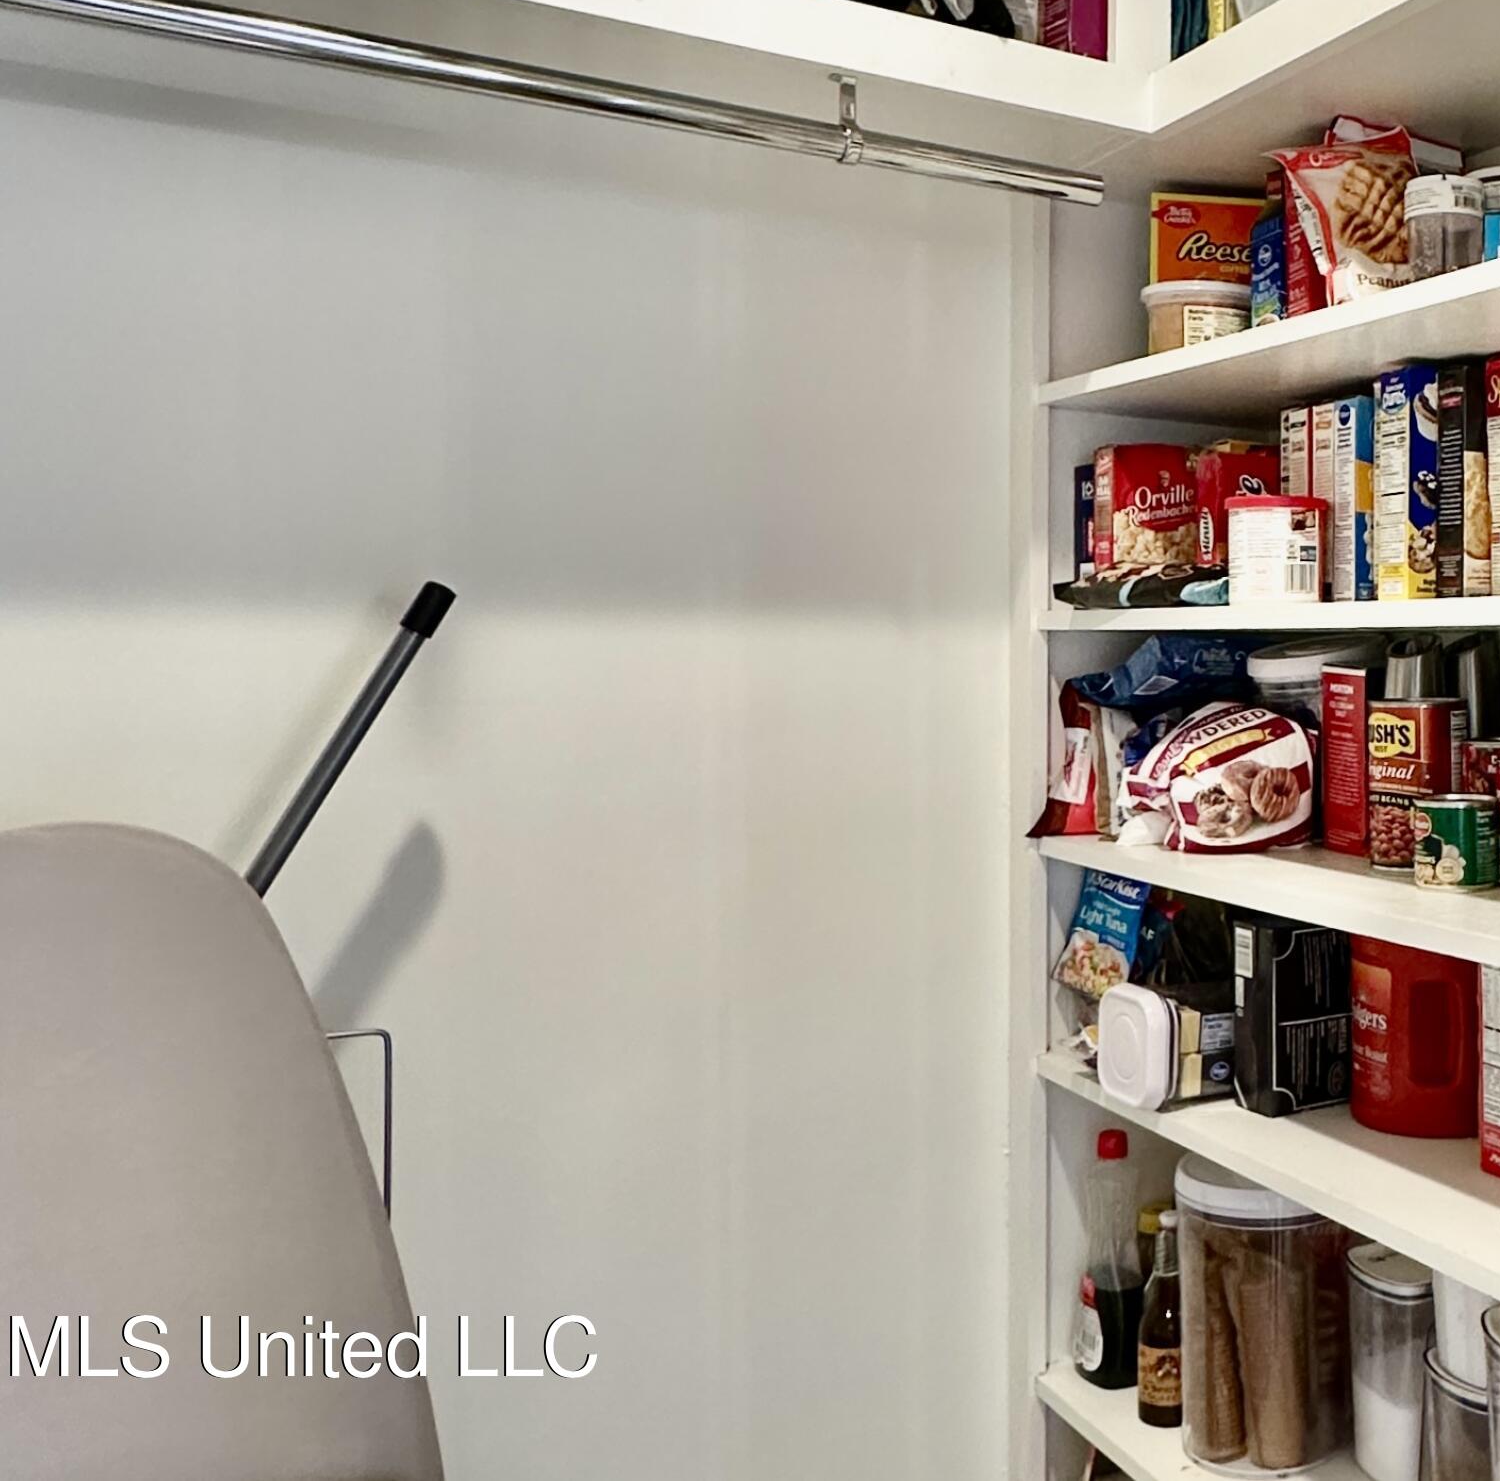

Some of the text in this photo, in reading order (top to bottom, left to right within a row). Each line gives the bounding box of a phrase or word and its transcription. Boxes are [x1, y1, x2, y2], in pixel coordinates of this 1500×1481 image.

[1134, 484, 1195, 510] Orville
[1368, 723, 1412, 749] USH'S
[1079, 905, 1129, 935] Light Tuna
